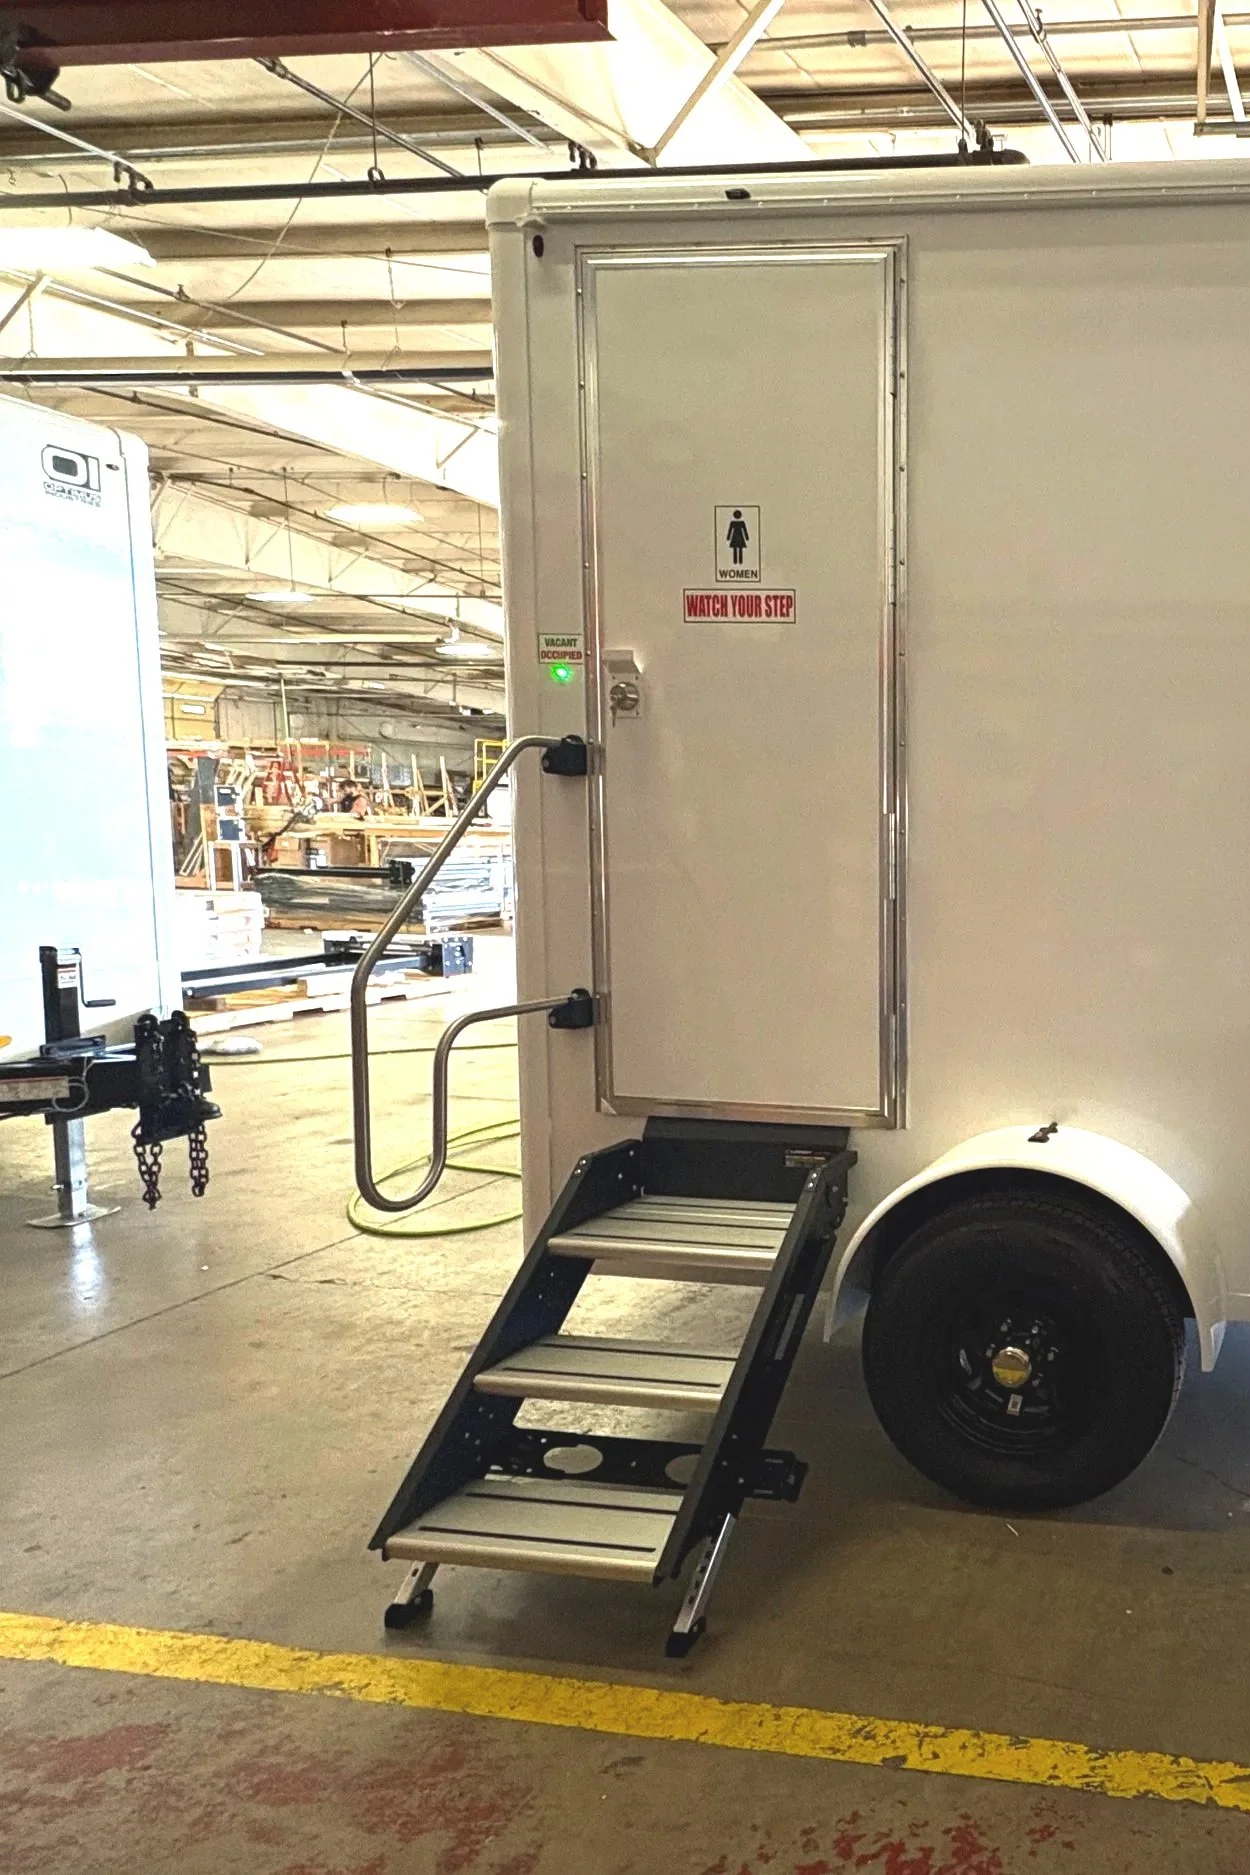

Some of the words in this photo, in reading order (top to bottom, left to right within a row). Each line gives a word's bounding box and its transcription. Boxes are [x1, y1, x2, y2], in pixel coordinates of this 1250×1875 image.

[719, 569, 758, 579] WOMEN
[686, 594, 728, 617] WATCH
[730, 595, 762, 617] YOUR
[764, 595, 793, 618] STEP
[544, 637, 578, 647] VACANT
[541, 650, 582, 660] OCCUPIED
